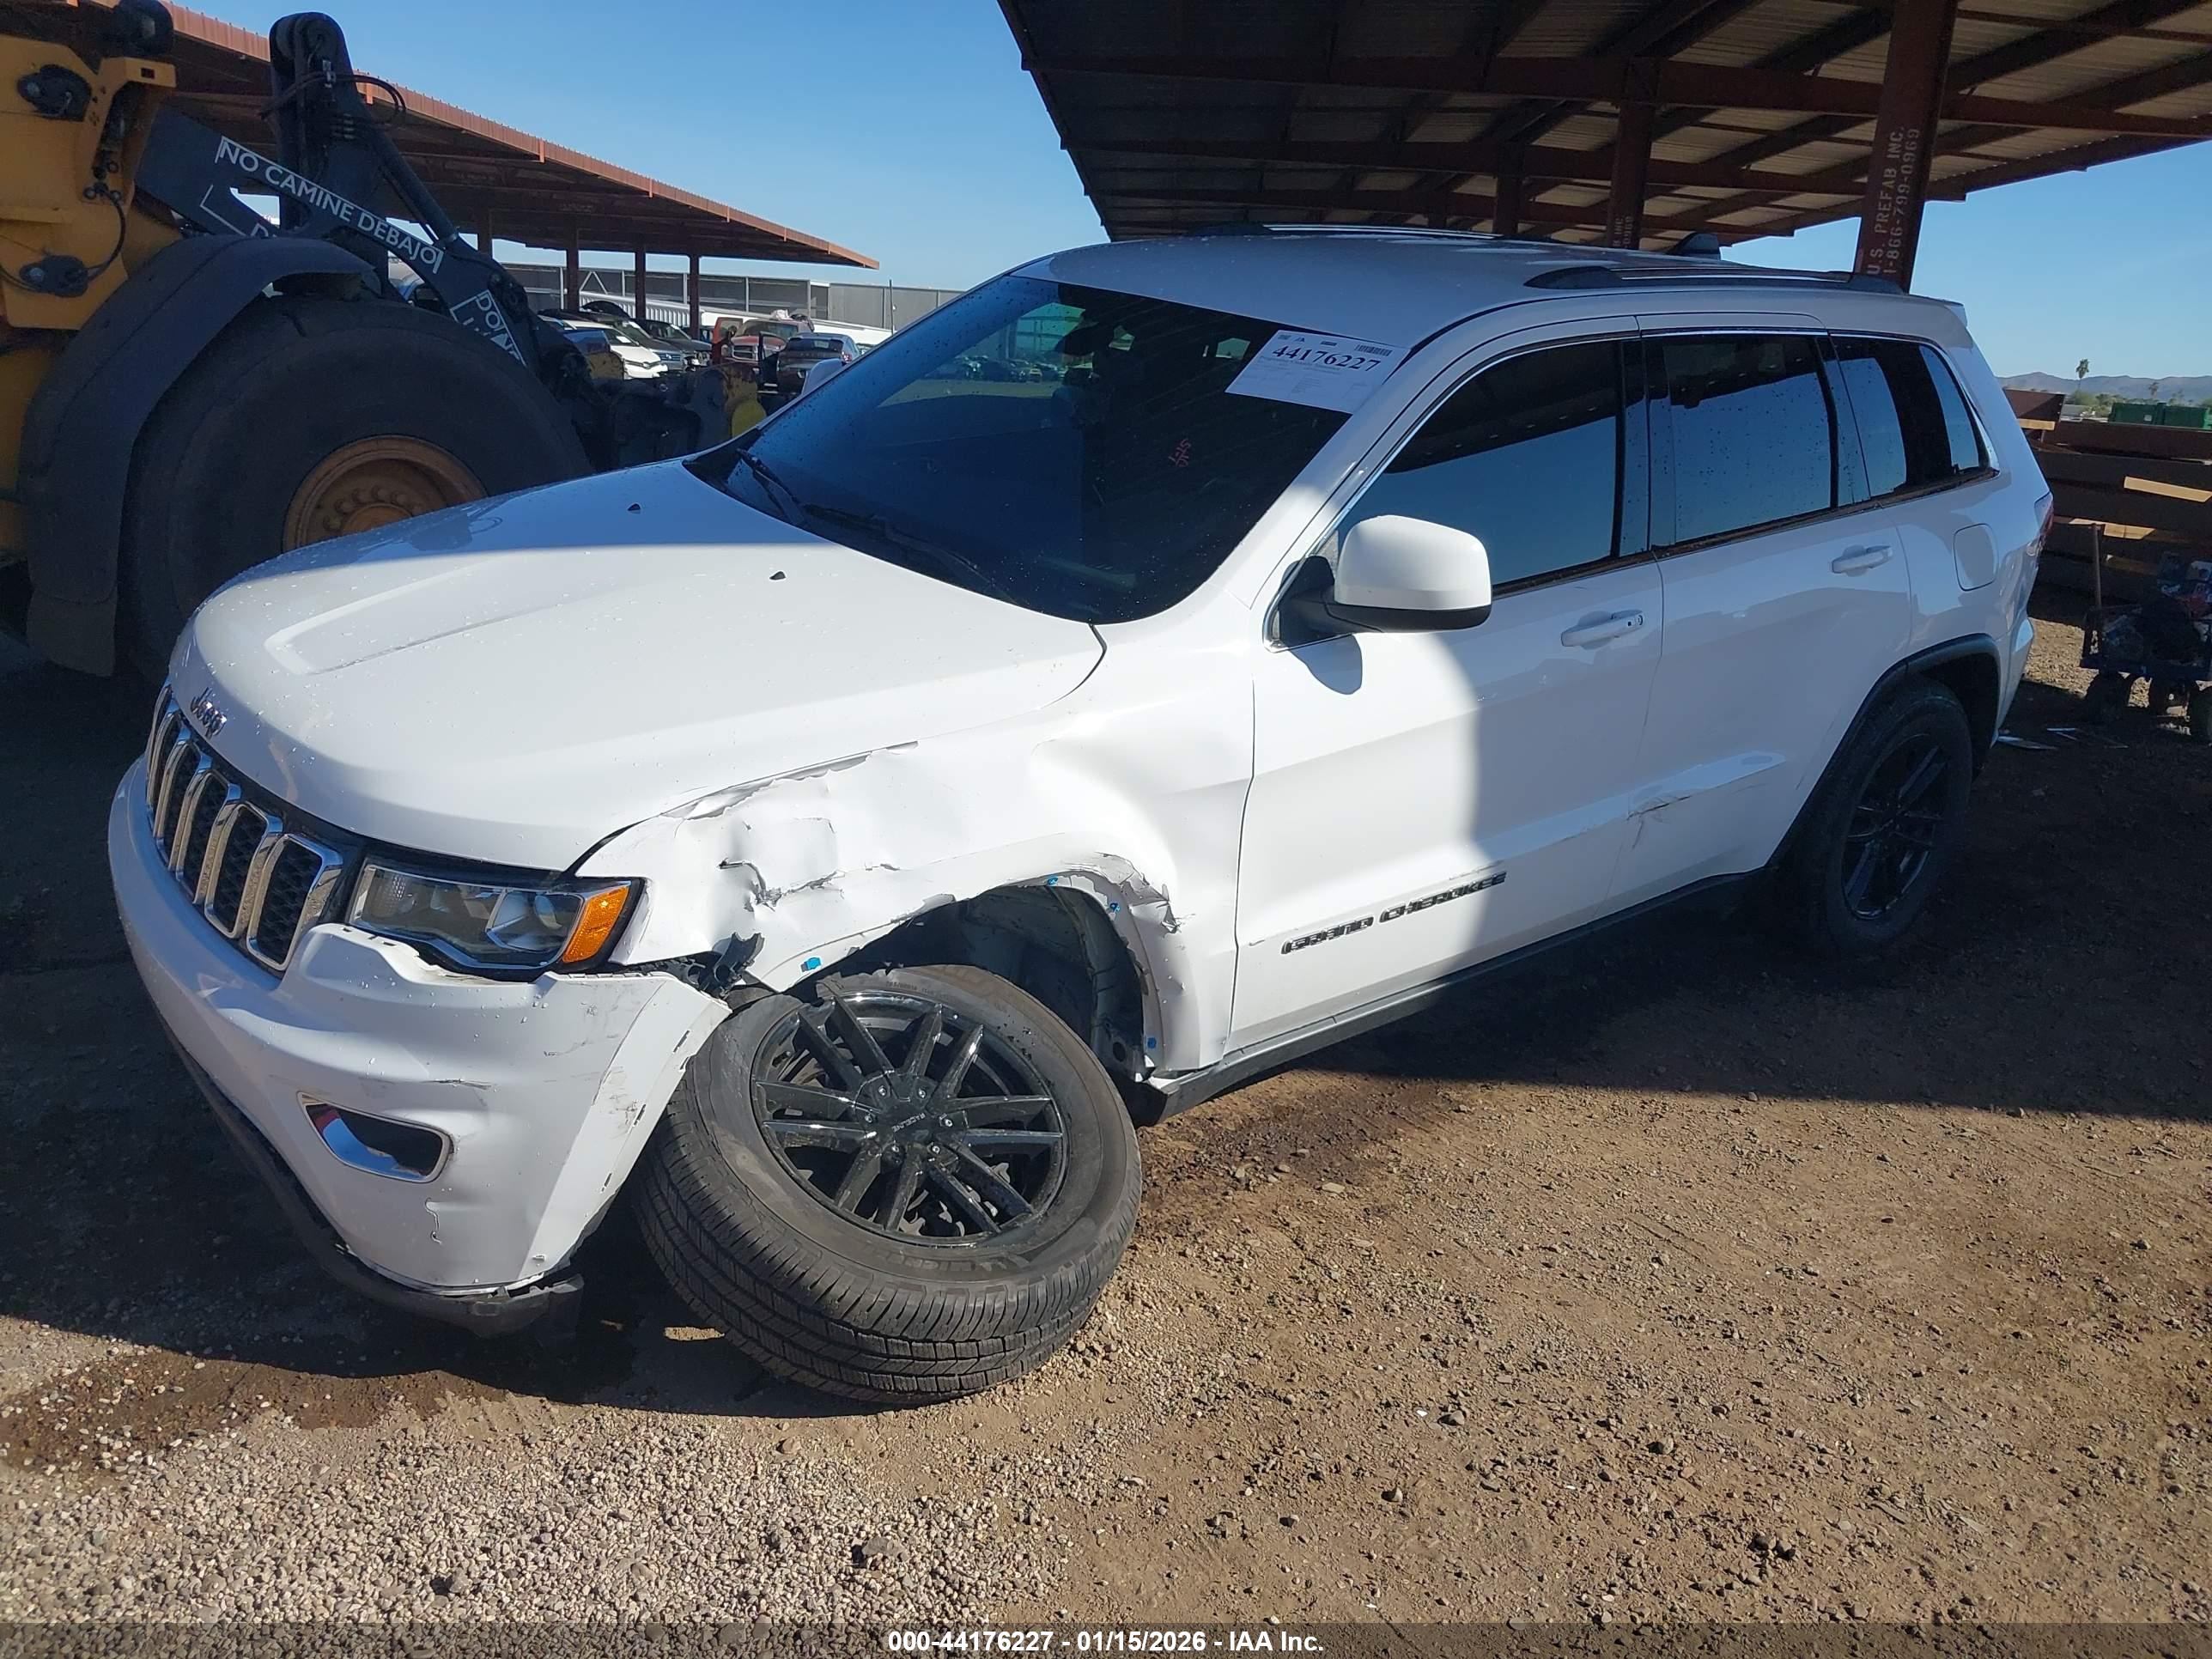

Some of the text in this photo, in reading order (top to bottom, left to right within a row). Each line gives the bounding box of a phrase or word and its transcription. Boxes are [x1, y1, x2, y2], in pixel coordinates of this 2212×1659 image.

[220, 140, 438, 264] NO CAMINE DEBAJO
[1868, 126, 1905, 275] U.S. PREFAB INC.
[1273, 345, 1381, 372] 44176227
[1280, 871, 1508, 955] GRAND CHEROKEE
